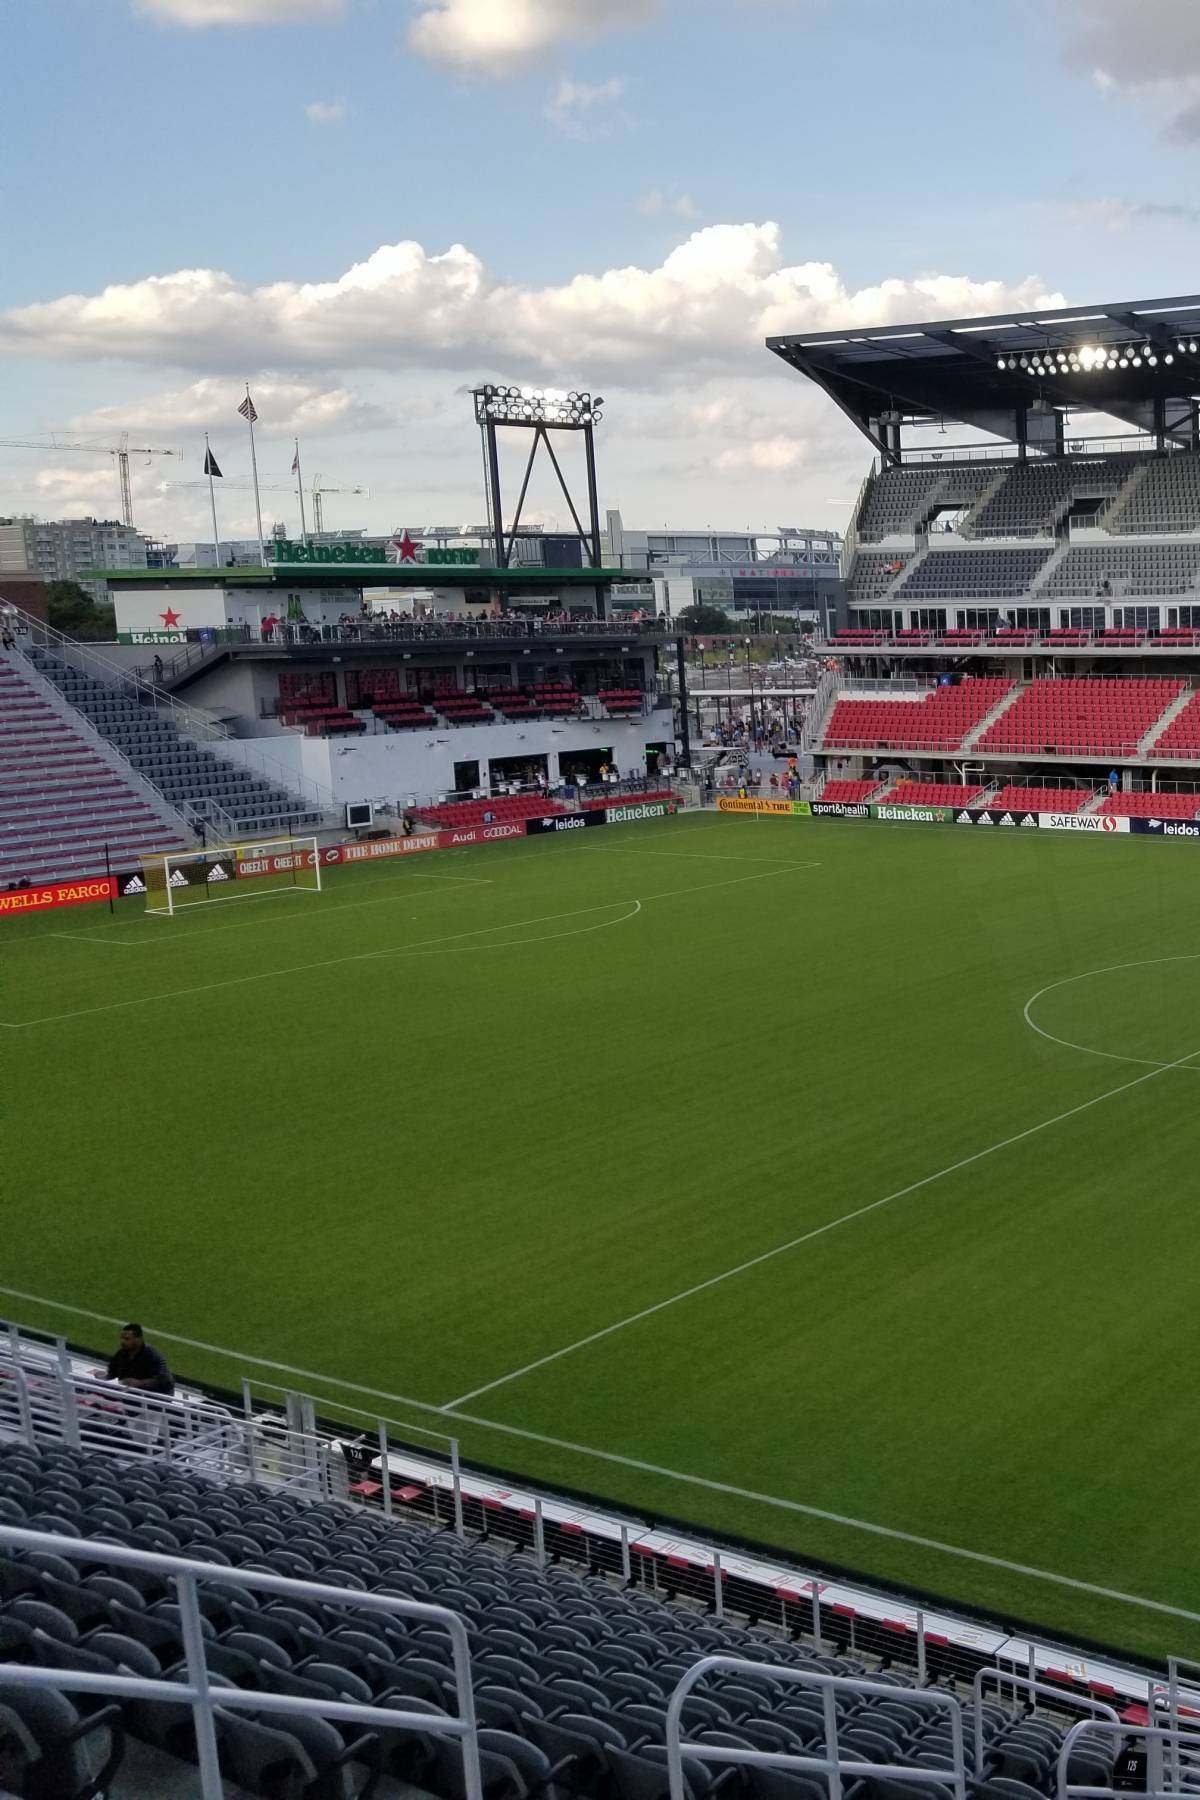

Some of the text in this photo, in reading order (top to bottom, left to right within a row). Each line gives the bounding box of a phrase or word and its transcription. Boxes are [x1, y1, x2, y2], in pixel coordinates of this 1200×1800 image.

[274, 539, 387, 562] Heineken
[719, 799, 763, 811] Continental
[772, 803, 791, 812] TIRE
[813, 803, 869, 816] sport&health
[605, 804, 665, 824] Heineken
[877, 806, 934, 822] Heineken
[554, 817, 586, 831] leidos
[1050, 816, 1101, 829] SAFEWAY
[1163, 822, 1200, 836] leidos
[452, 831, 476, 843] Audi
[344, 836, 437, 859] THE HOME DEPOT
[0, 883, 110, 909] WELLS FARGO
[123, 885, 148, 895] adidas
